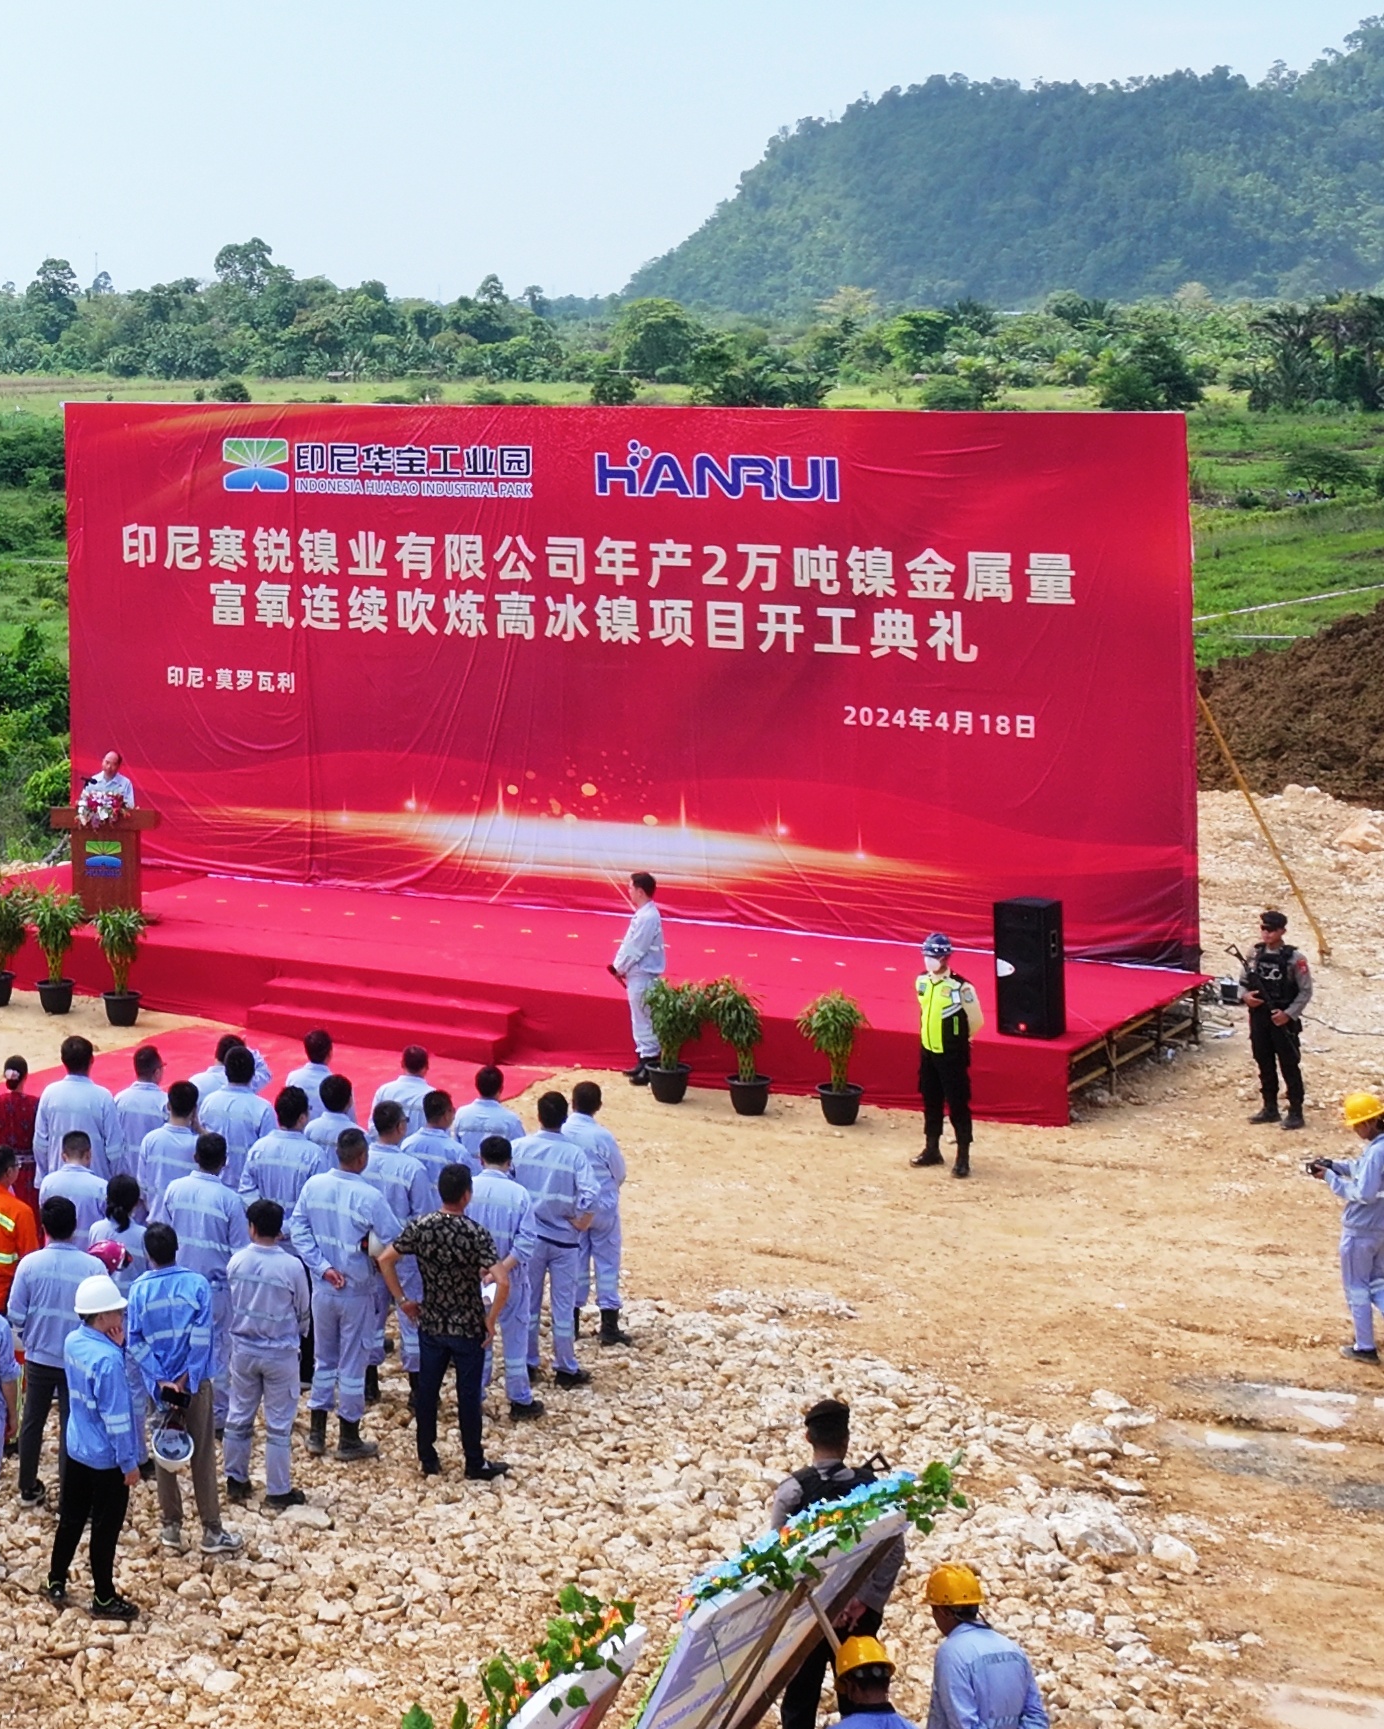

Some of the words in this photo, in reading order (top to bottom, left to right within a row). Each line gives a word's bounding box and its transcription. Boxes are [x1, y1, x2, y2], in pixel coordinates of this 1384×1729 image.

[295, 443, 533, 478] 印尼华宝工业园
[595, 439, 840, 502] HANRUI
[295, 477, 362, 494] INDONESIA
[365, 479, 419, 495] HUABAO
[421, 481, 496, 497] INDUSTRIAL
[498, 482, 533, 498] PARK
[122, 523, 1077, 606] 印尼寒锐镍业有限公司年产2万吨镍金属量
[210, 579, 979, 663] 富氧连续吹炼高冰镍项目开工典礼
[843, 705, 1036, 739] 2024年4月18日
